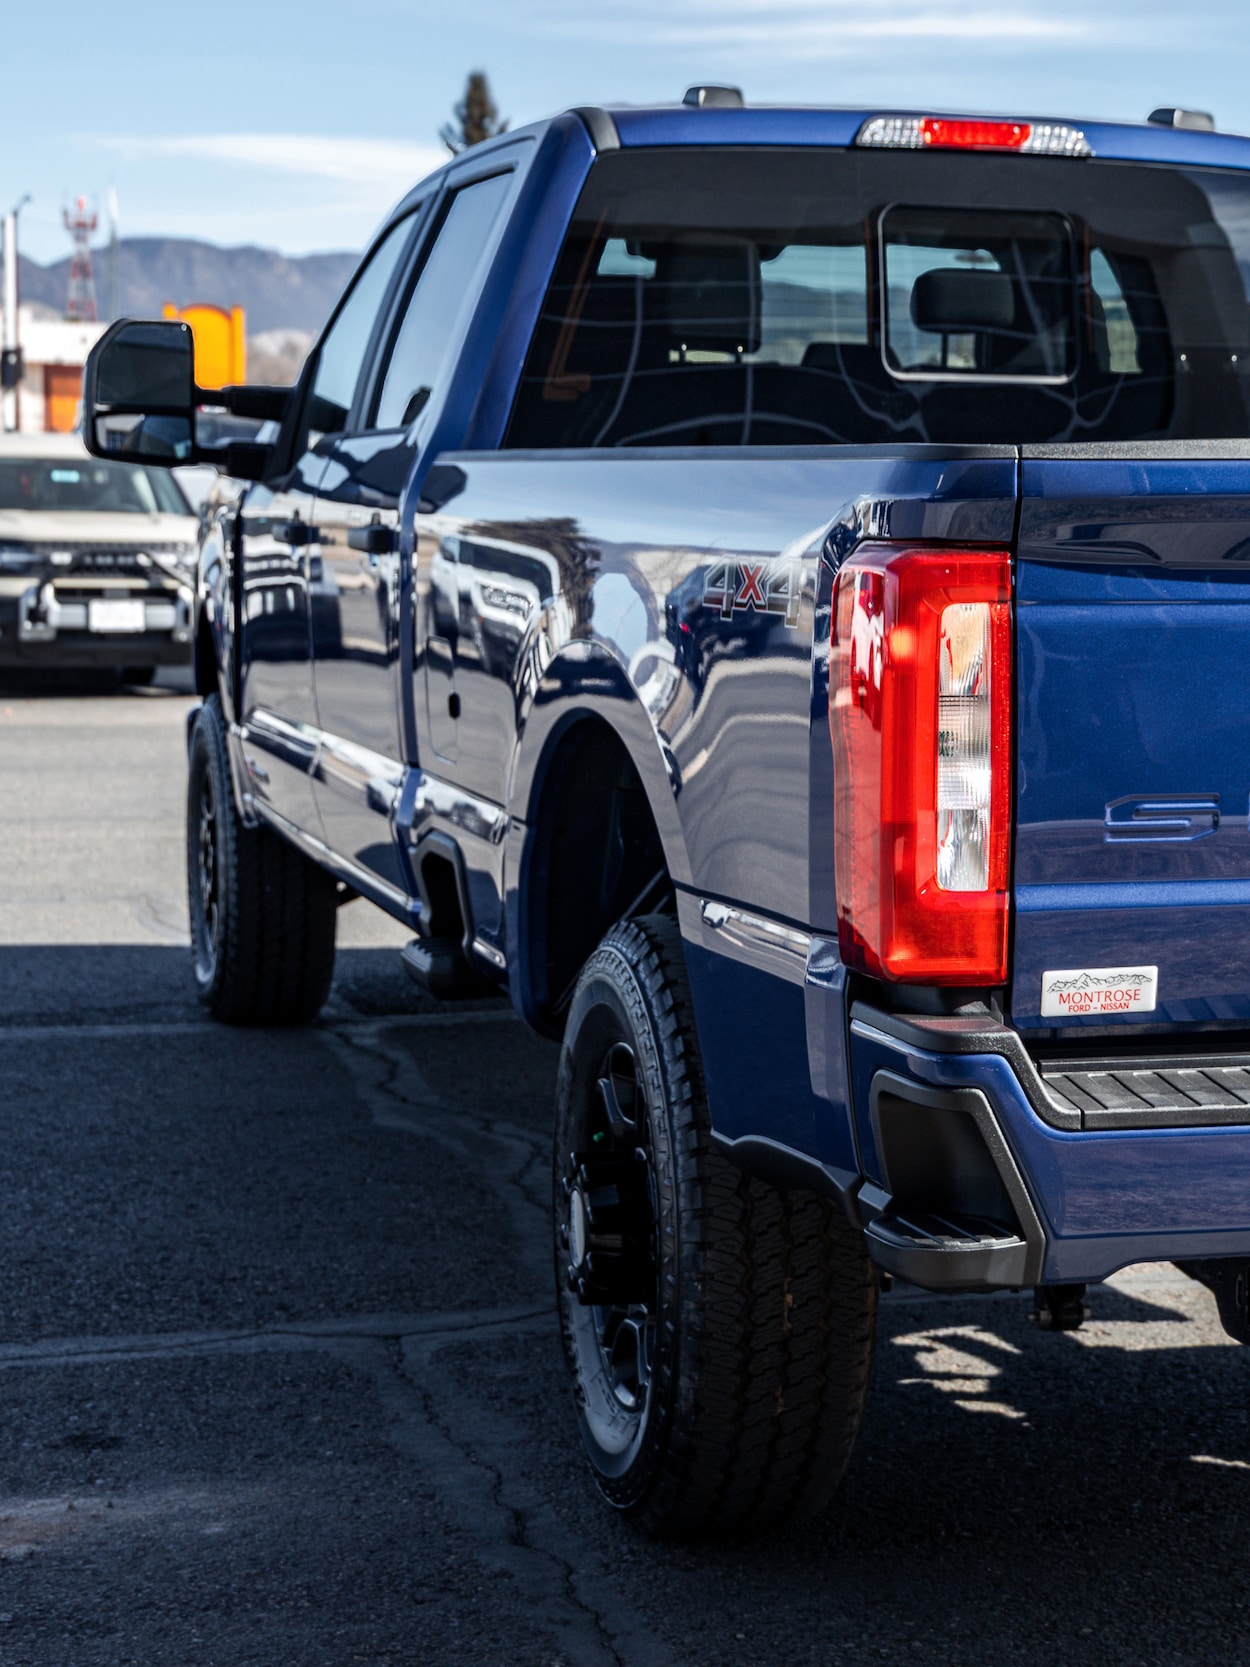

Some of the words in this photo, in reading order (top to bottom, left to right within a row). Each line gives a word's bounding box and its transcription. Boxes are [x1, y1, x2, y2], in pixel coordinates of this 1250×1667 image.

[1058, 988, 1142, 1005] MONTROSE
[1068, 1004, 1091, 1013] FORD
[1100, 1002, 1130, 1011] NISSAN
